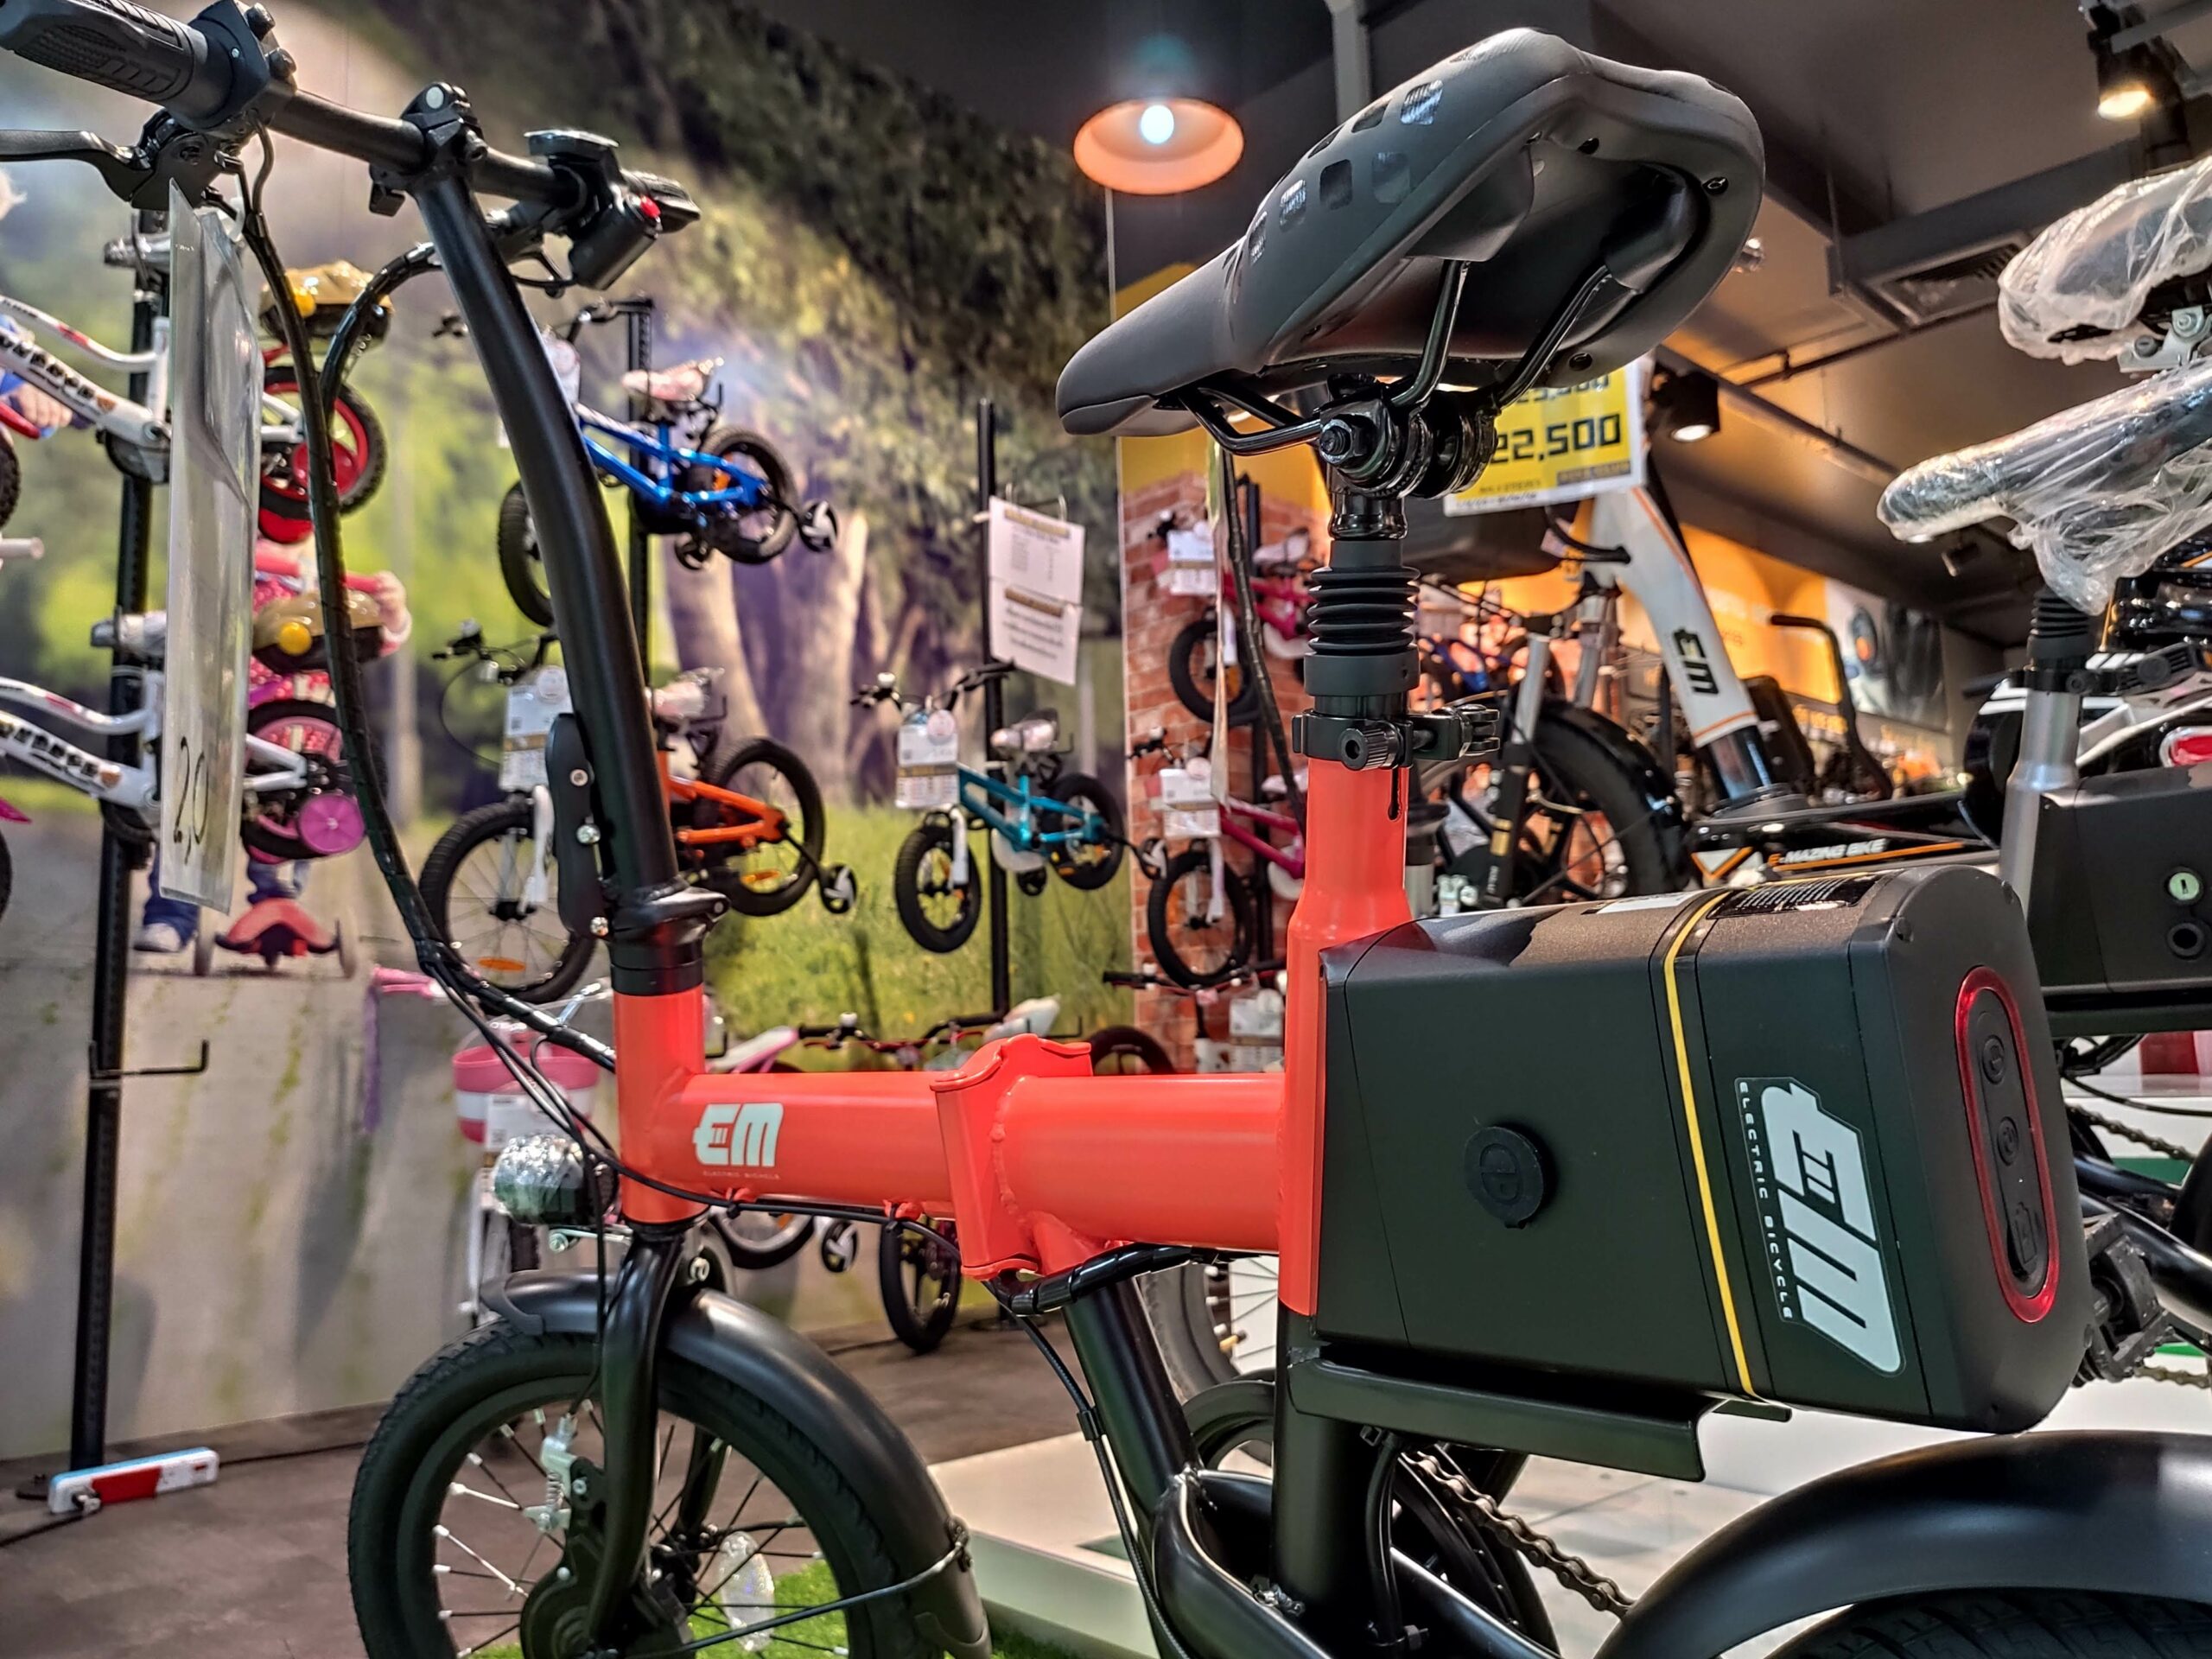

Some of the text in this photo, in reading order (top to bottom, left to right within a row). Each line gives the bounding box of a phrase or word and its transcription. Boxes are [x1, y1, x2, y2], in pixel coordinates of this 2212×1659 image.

[1491, 413, 1622, 465] 22,500
[1846, 837, 1887, 857] BIKE
[693, 1102, 785, 1167] EM
[1739, 1082, 1793, 1319] ELECTRIC BICYCLE
[1761, 1083, 1901, 1373] EM
